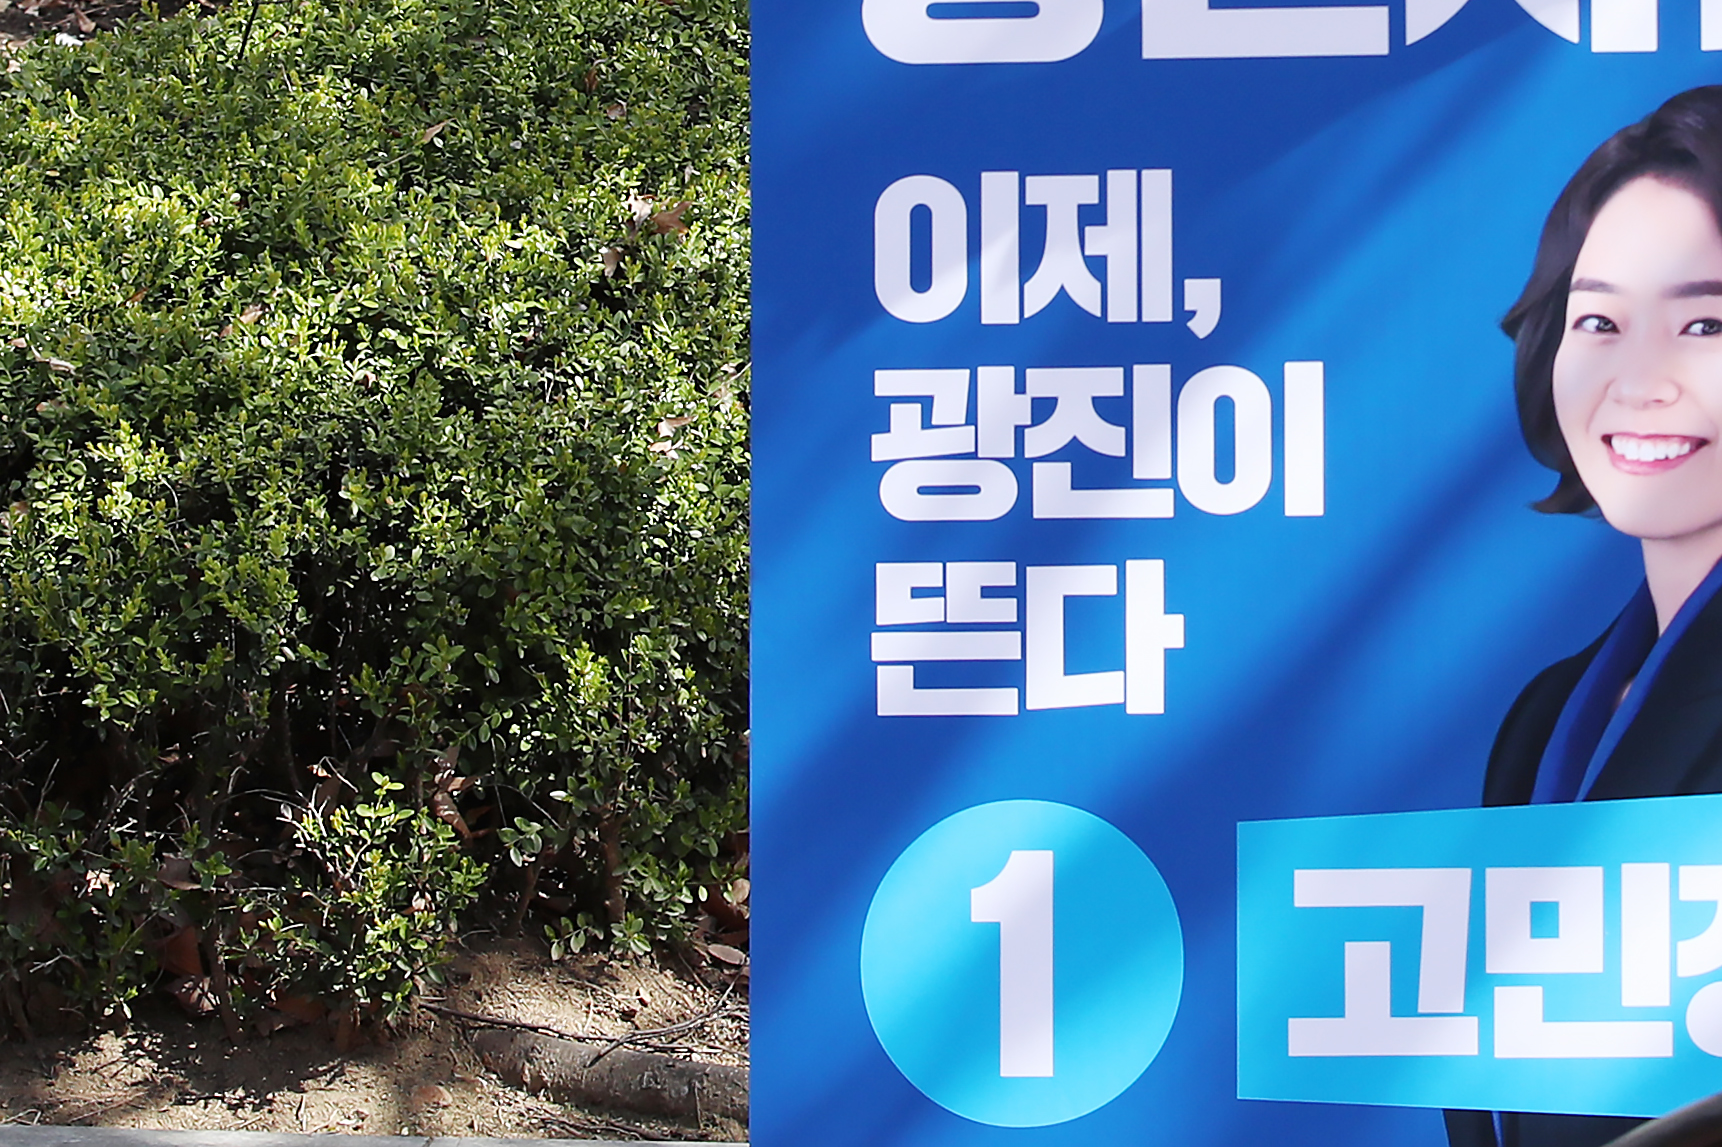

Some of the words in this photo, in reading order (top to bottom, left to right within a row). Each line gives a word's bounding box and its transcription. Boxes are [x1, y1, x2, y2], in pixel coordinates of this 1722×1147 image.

[873, 169, 1222, 339] 이제,
[871, 361, 1326, 523] 광진이
[870, 559, 1185, 716] 뜬다
[970, 849, 1055, 1078] 1
